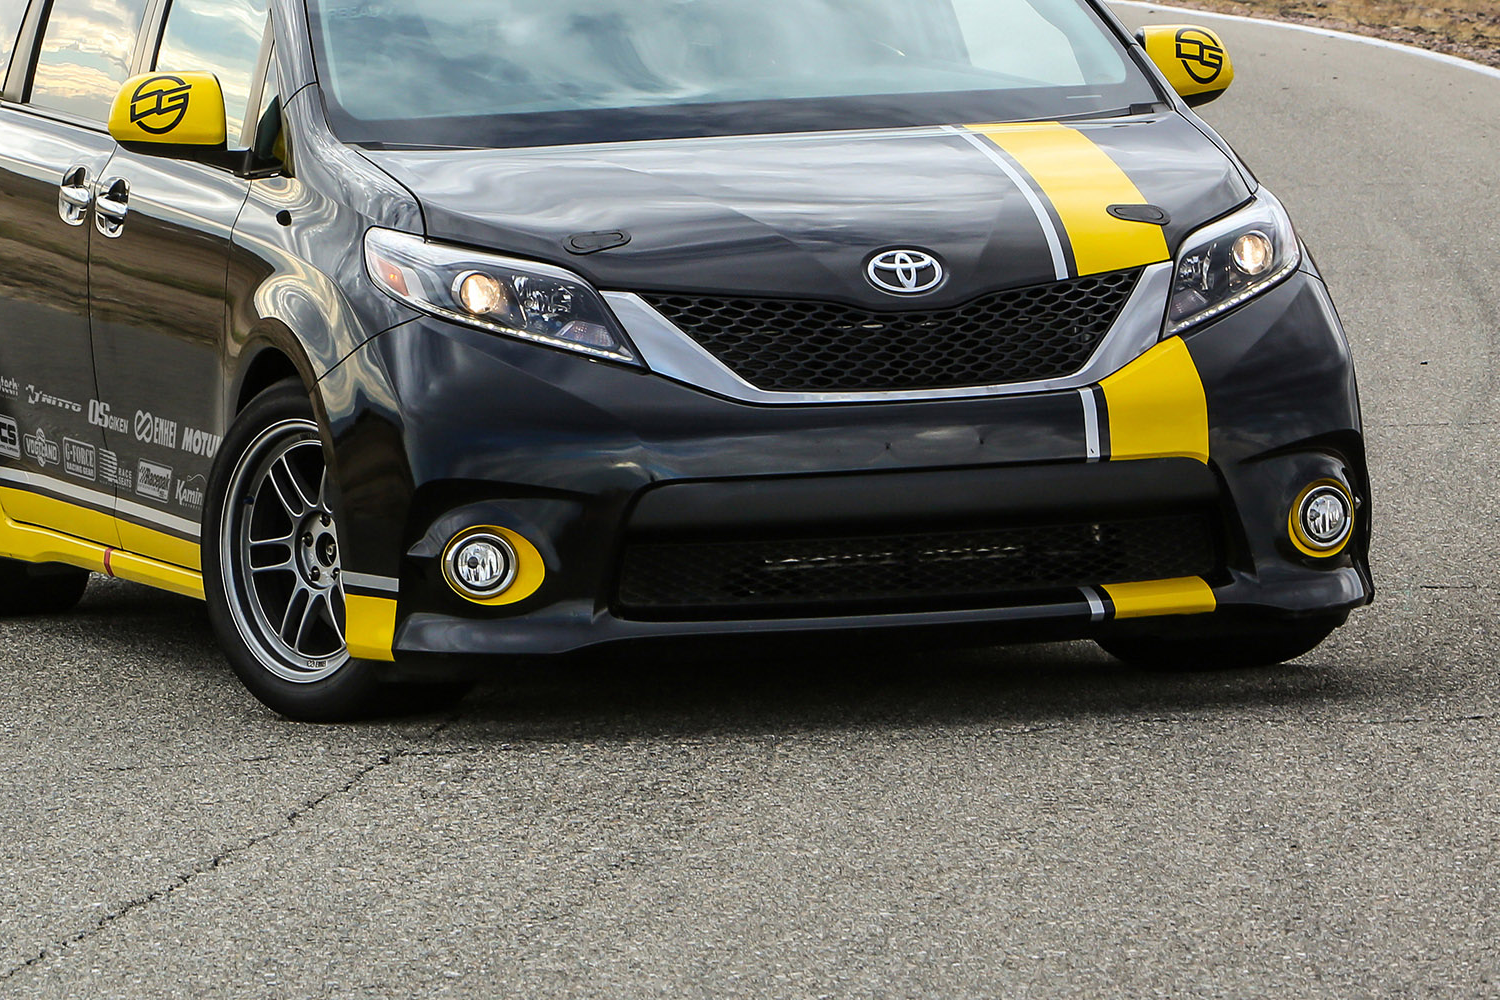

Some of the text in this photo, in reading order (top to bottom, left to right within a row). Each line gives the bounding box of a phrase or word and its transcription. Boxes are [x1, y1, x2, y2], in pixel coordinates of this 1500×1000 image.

[41, 393, 82, 412] NITTO
[88, 398, 129, 434] OS GIKEN
[153, 416, 177, 449] ENKEI
[65, 442, 94, 467] G-FORCE
[66, 461, 94, 477] RACING GEAR
[118, 467, 132, 479] RACE
[117, 476, 133, 489] SEATS
